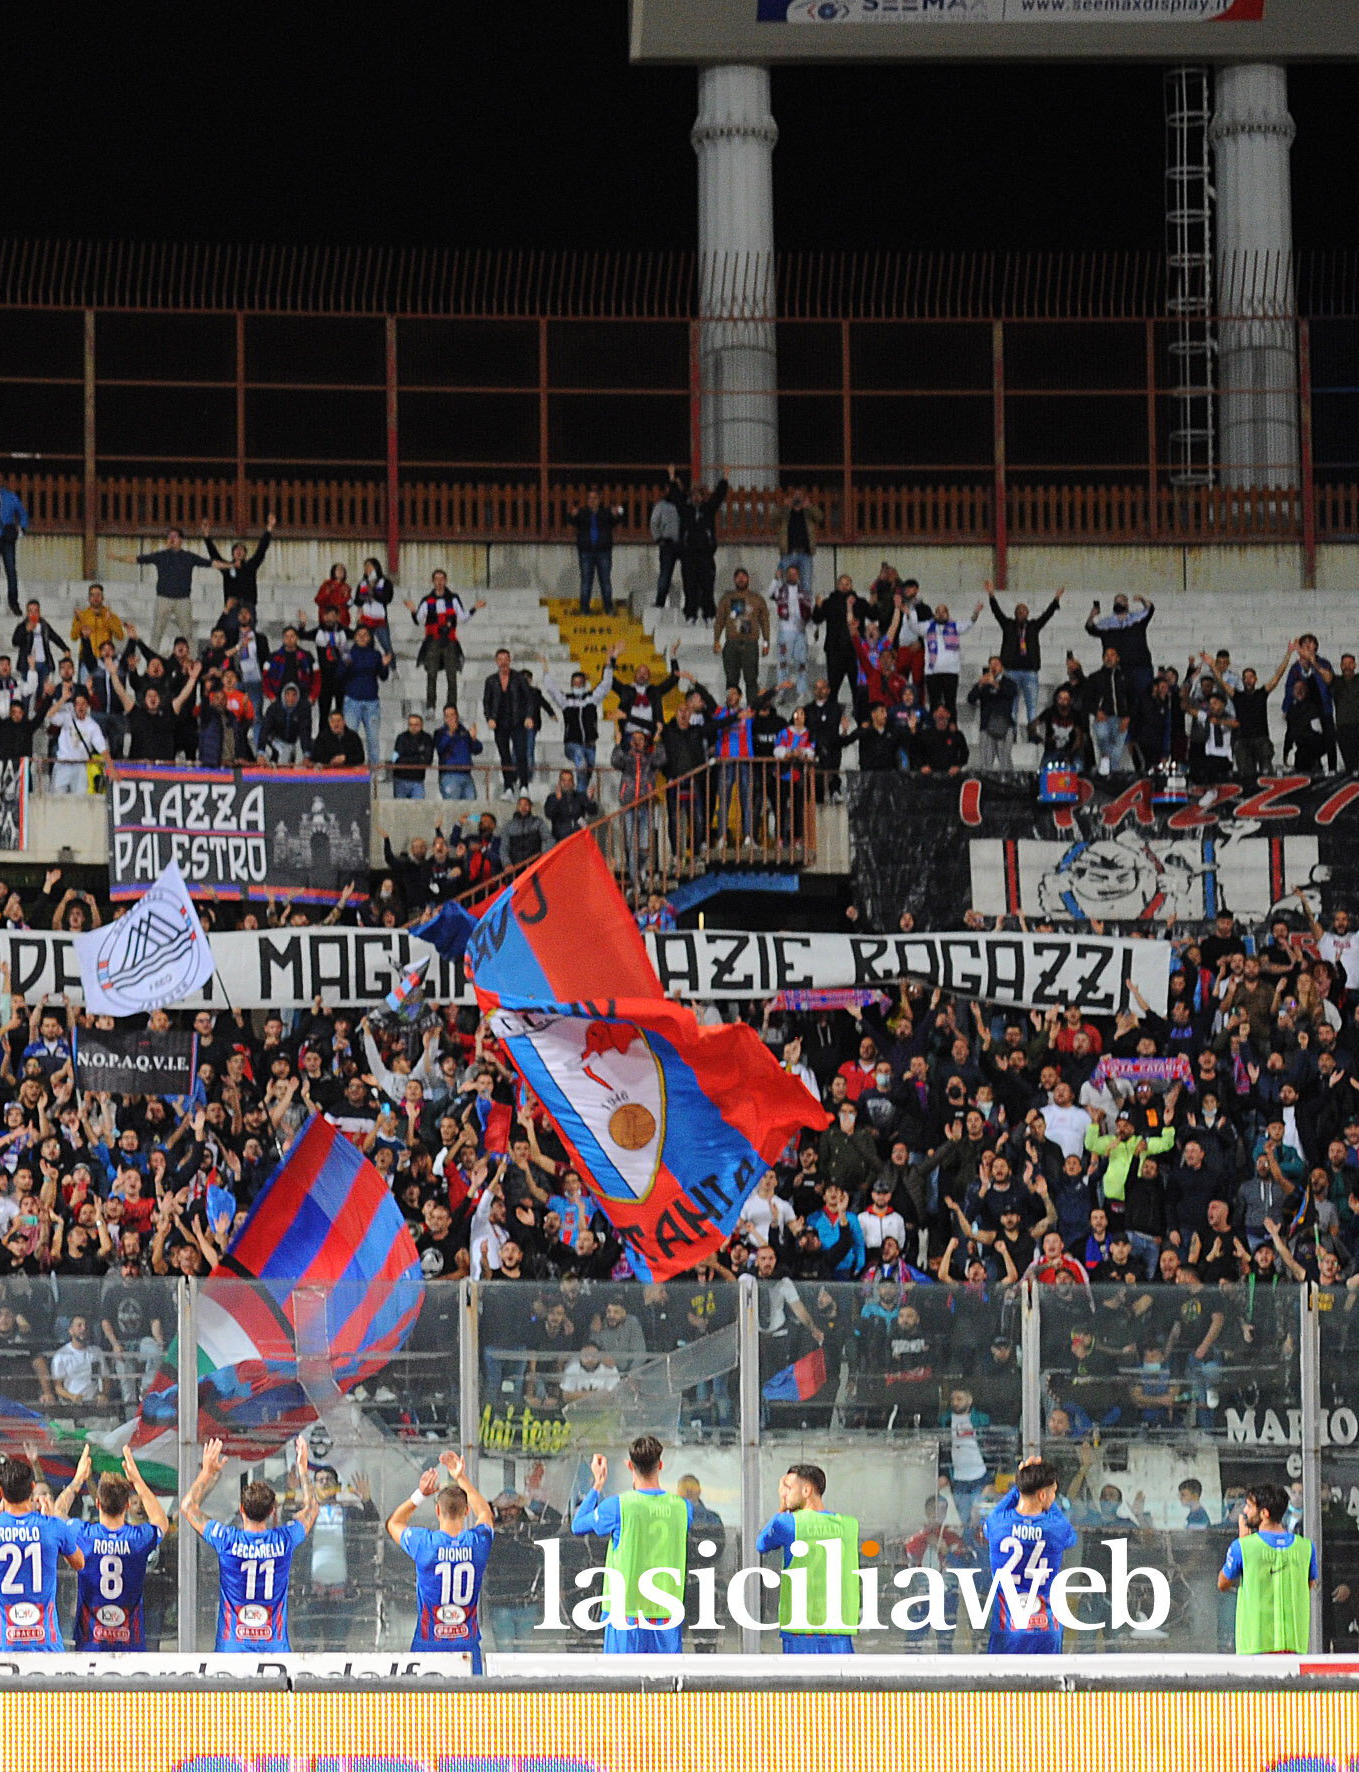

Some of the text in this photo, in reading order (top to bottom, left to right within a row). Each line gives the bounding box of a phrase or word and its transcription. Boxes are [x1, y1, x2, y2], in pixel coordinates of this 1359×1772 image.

[113, 780, 265, 832] PIAZZA
[114, 832, 267, 882] PALESTRO
[655, 932, 814, 992] AZIE
[77, 1051, 190, 1072] N.O.P.A.Q.V.I.E.
[93, 1538, 131, 1555] ROSAIA
[231, 1540, 285, 1559] CECCARELLI
[1012, 1523, 1043, 1541] MORO
[438, 1546, 473, 1562] BIONDI
[999, 1536, 1050, 1586] 24
[99, 1555, 124, 1600] 8
[240, 1559, 275, 1600] 11
[434, 1561, 476, 1606] 10
